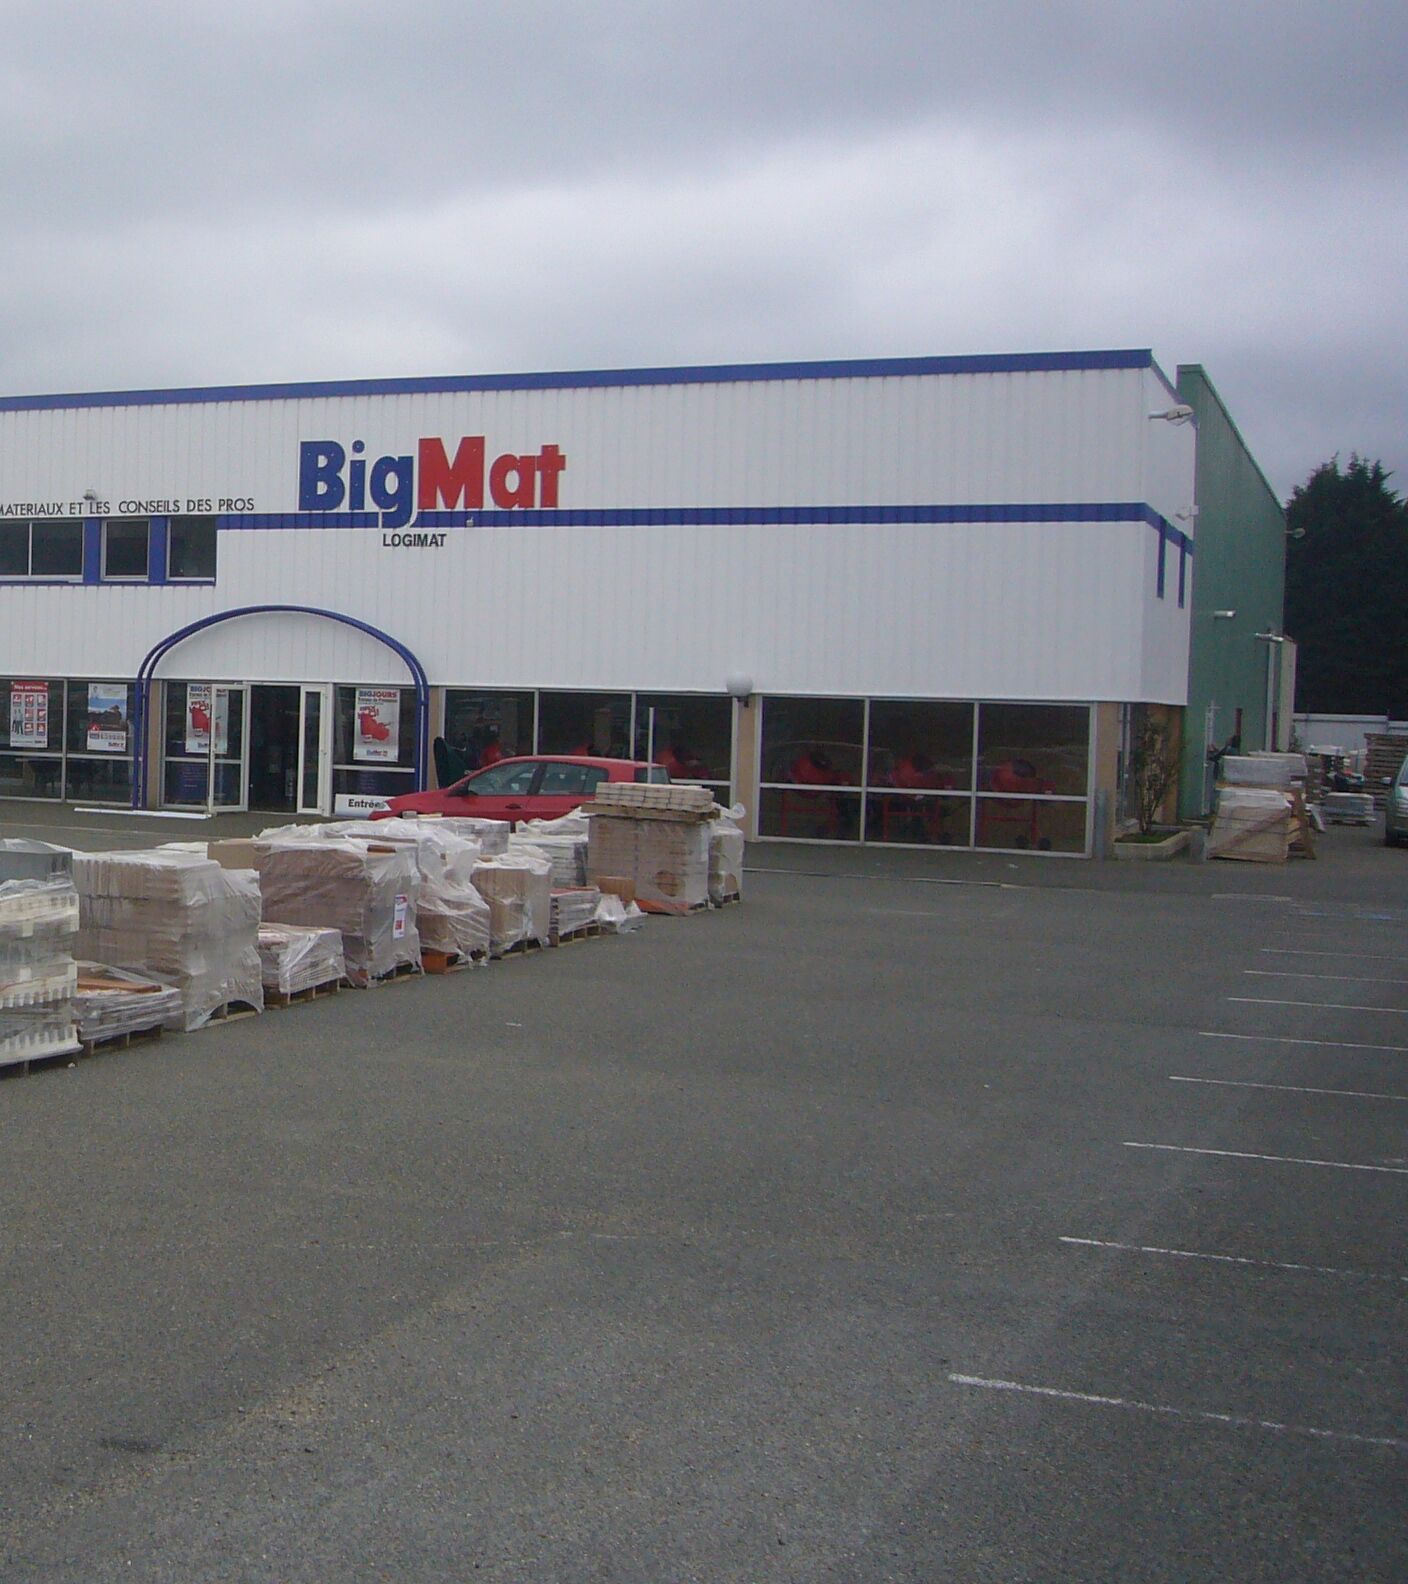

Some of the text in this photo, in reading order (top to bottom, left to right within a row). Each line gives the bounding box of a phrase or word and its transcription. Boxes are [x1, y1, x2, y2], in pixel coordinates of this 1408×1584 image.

[298, 436, 566, 528] BigMat
[69, 502, 84, 515] ET
[89, 501, 111, 514] LES
[118, 500, 180, 514] CONSEILS
[186, 499, 212, 512] DES
[218, 498, 254, 511] PROS
[382, 533, 447, 547] LOGIMAT
